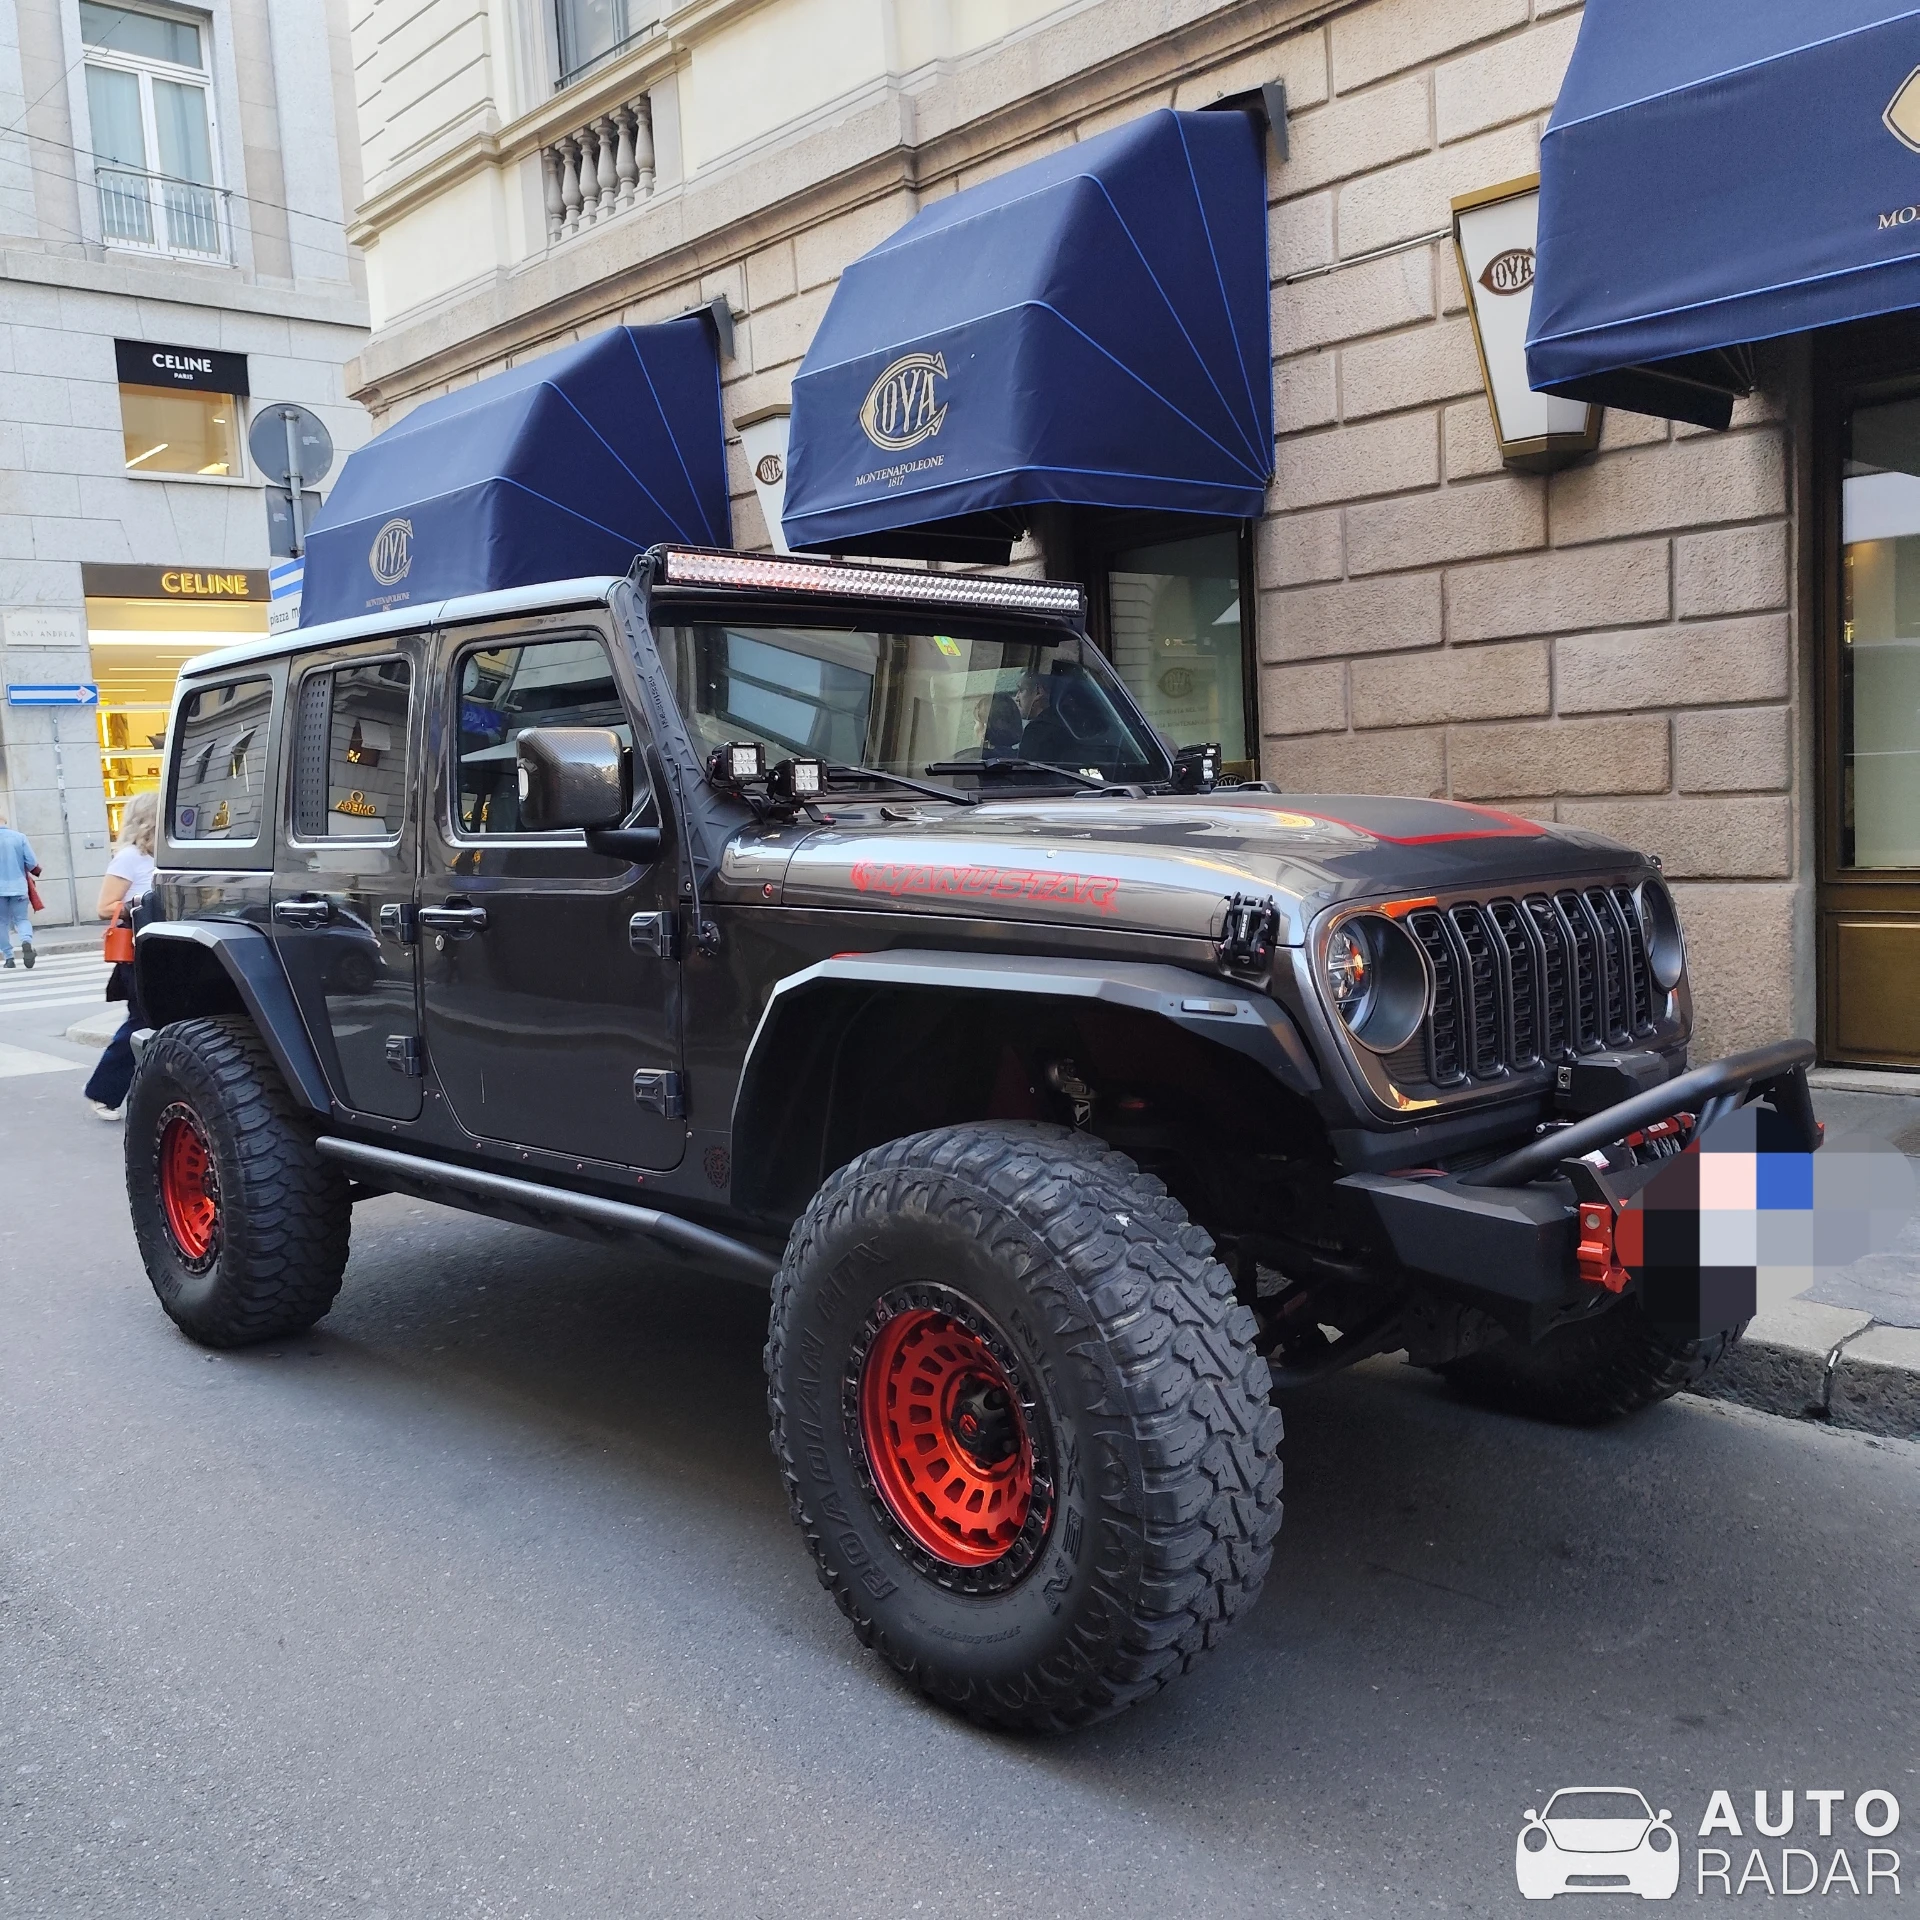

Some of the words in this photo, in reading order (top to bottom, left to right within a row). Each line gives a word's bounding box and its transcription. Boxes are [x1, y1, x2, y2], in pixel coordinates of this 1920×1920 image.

[1878, 204, 1920, 230] MO
[152, 353, 213, 373] CELINE
[173, 372, 194, 380] PARIS
[859, 352, 949, 451] COYA
[855, 454, 945, 487] MONTENAPOLEONE
[887, 475, 905, 488] 1817
[161, 572, 250, 595] CELINE
[270, 612, 290, 627] piazza
[291, 607, 300, 619] m
[40, 630, 76, 638] ANDREA
[816, 1235, 891, 1322] MTX
[797, 1326, 900, 1601] ROADIAN
